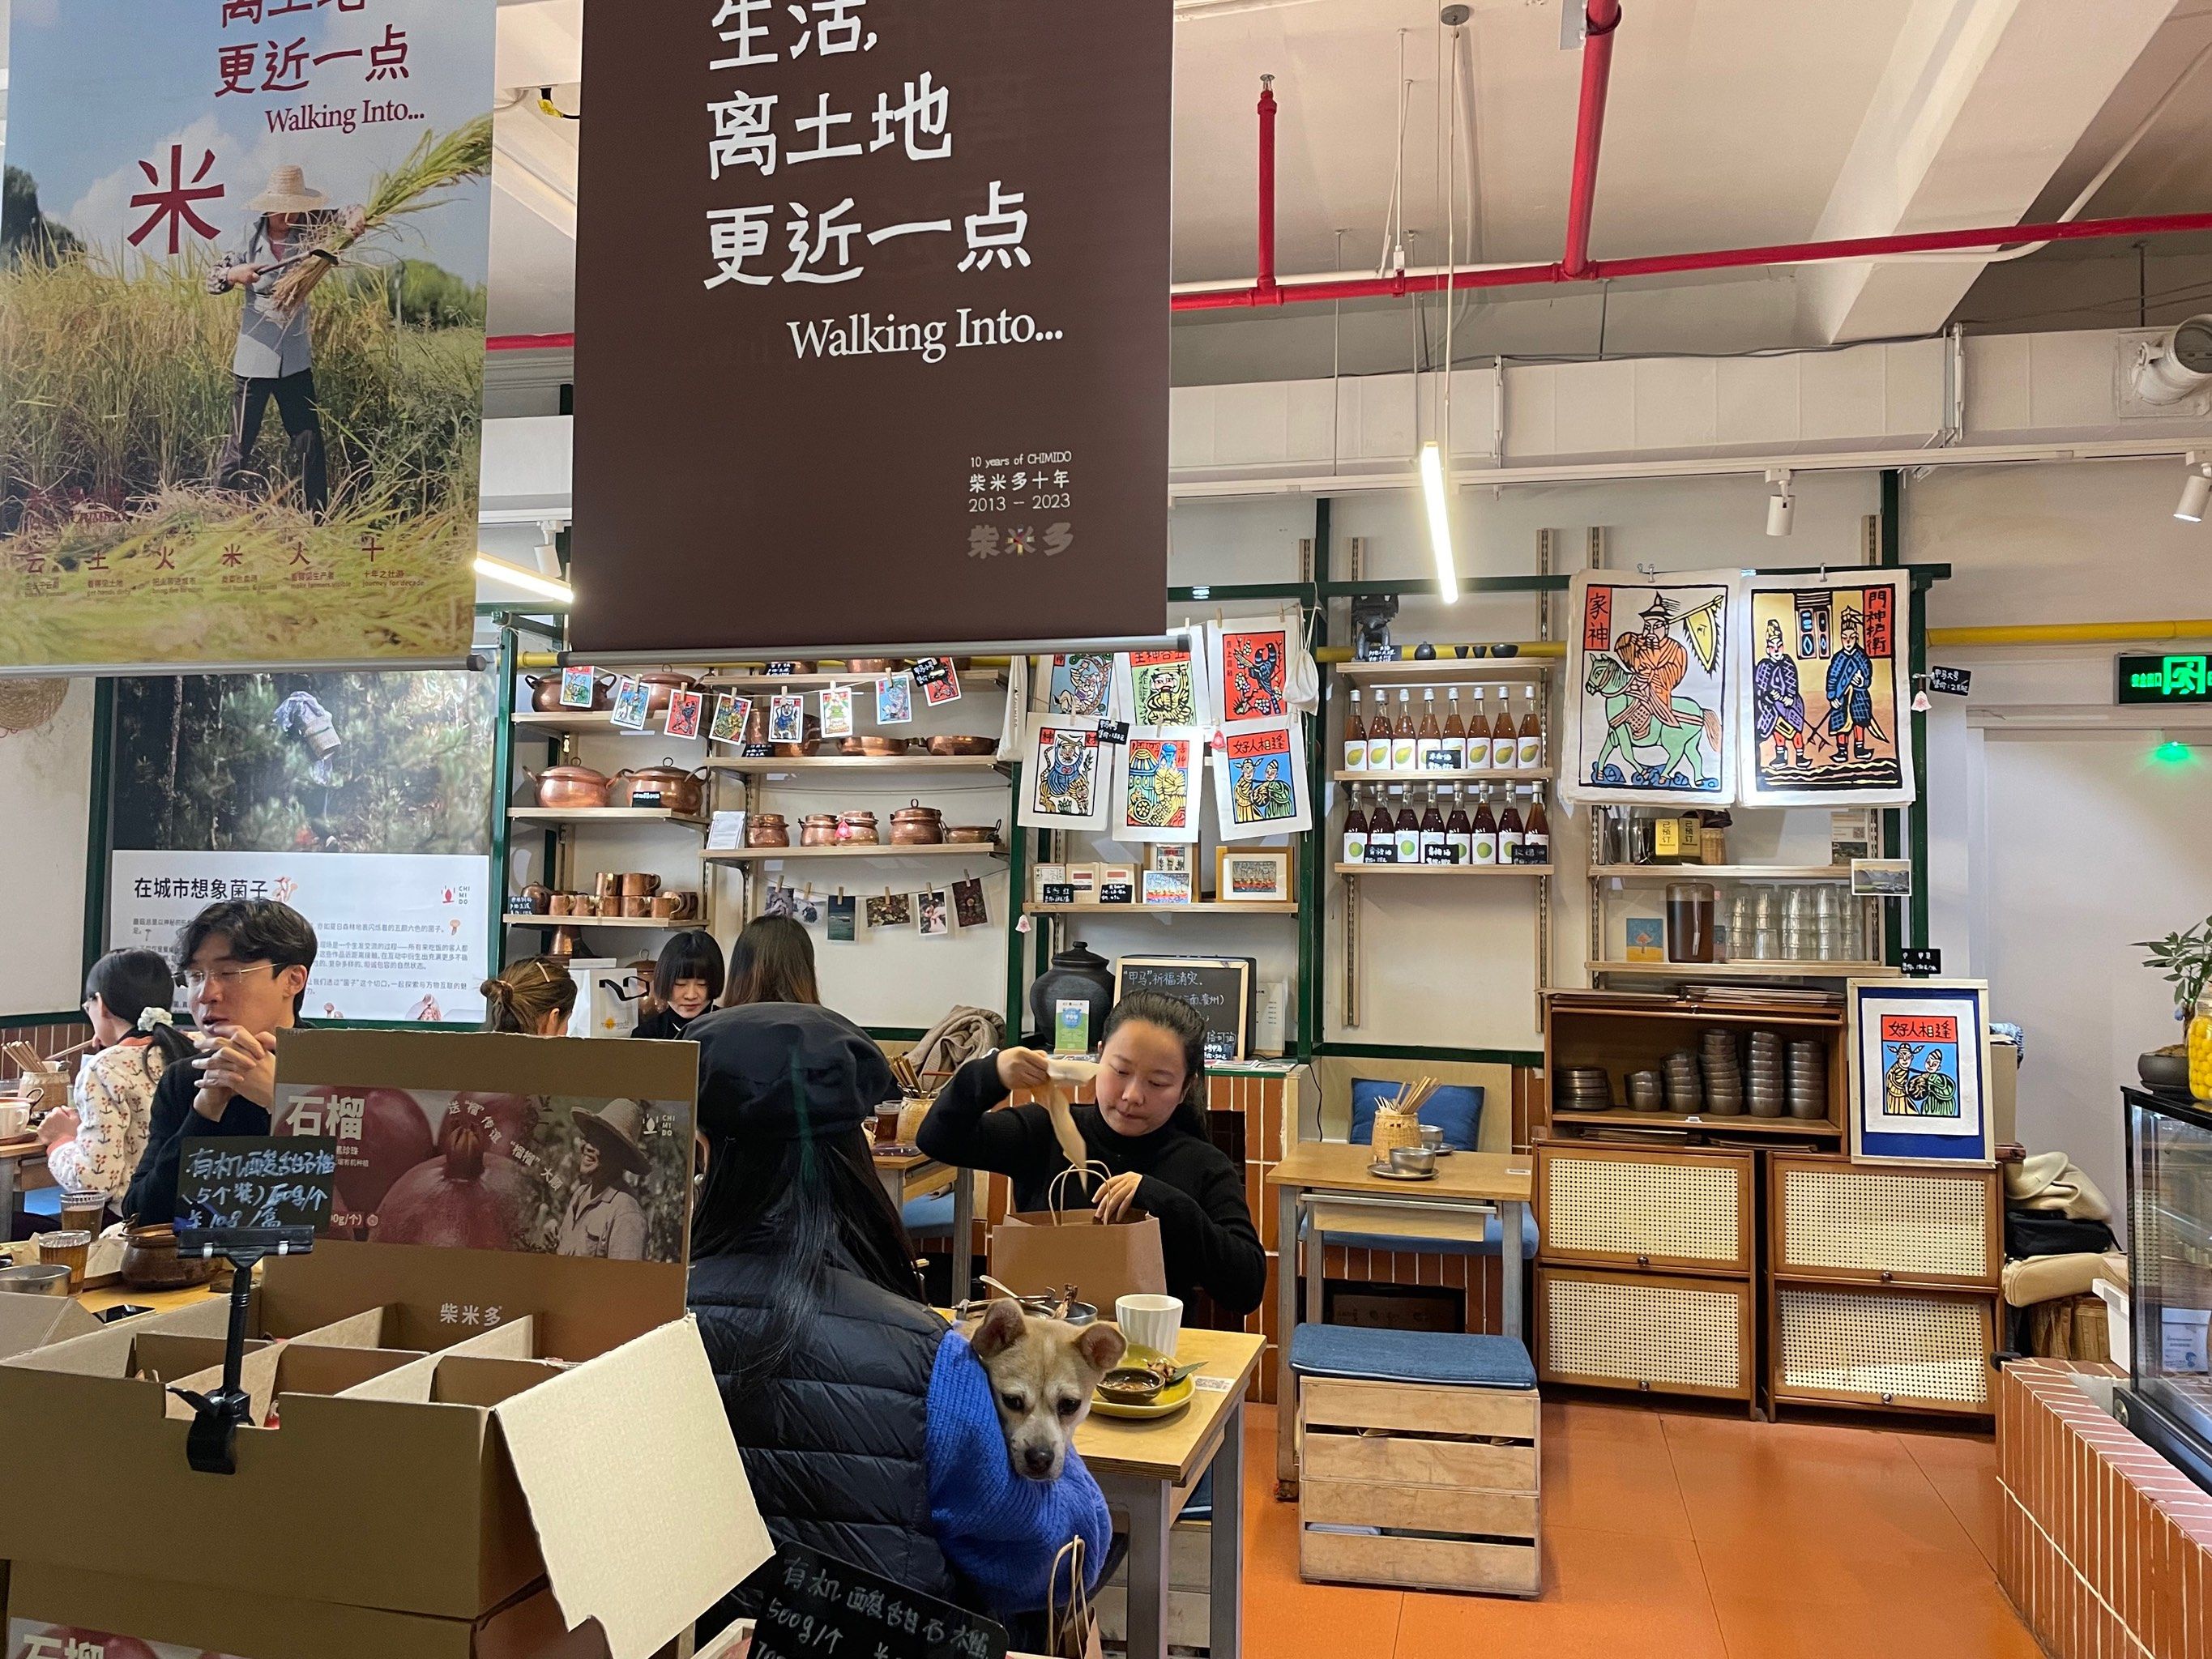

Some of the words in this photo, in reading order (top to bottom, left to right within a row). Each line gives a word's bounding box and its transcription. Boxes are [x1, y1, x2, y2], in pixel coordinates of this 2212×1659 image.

[215, 24, 409, 97] 更近一点
[265, 104, 357, 134] Walking
[362, 99, 425, 125] Into...
[707, 72, 952, 180] 离土地
[127, 144, 224, 254] 米
[704, 181, 1031, 290] 更近一点
[787, 313, 946, 363] Walking
[956, 307, 1064, 348] Into...
[971, 457, 981, 467] 10
[985, 458, 1010, 468] years
[1014, 454, 1023, 465] of
[1027, 451, 1072, 464] CHIMIDO
[969, 469, 1070, 493] 柴米多十年
[968, 497, 1006, 513] 2013
[1032, 493, 1070, 510] 2023
[88, 551, 109, 571] 土
[155, 546, 175, 570] 火
[222, 544, 243, 567] 米
[289, 541, 310, 565] 人
[362, 537, 385, 562] 十
[1589, 591, 1610, 648] 家神
[1233, 738, 1283, 754] 好人相逢
[1663, 821, 1672, 843] 已预订
[1685, 820, 1693, 842] 已预订
[134, 878, 268, 900] 在城市想象菌子
[1888, 1020, 1952, 1039] 好人相逢
[285, 1094, 365, 1141] 石榴
[331, 1213, 362, 1226] 0g/个)
[440, 1303, 503, 1327] 柴米多
